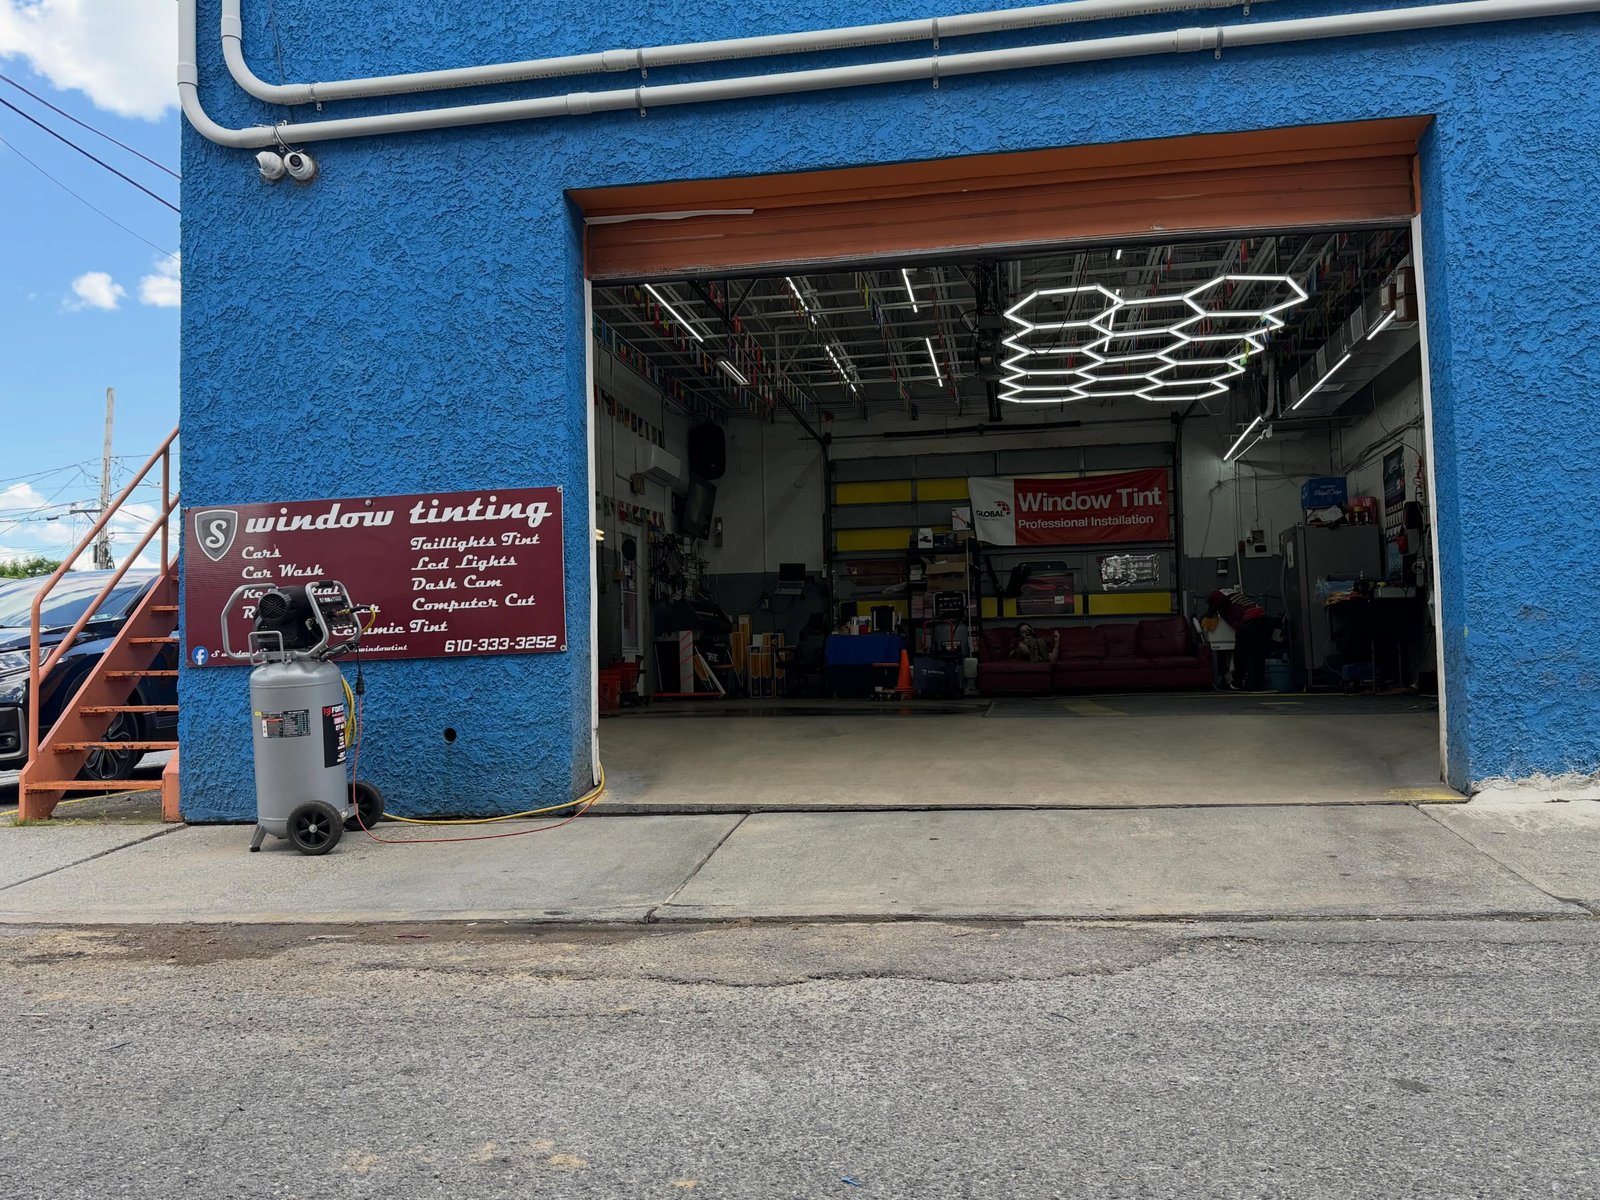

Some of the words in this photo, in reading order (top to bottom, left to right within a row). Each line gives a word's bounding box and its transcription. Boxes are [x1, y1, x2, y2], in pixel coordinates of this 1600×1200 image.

[1018, 491, 1112, 512] Window
[1116, 487, 1162, 508] Tint
[245, 503, 395, 533] window
[409, 495, 552, 528] tinting
[1018, 517, 1088, 530] Professional
[1091, 515, 1154, 527] Installation
[205, 520, 227, 548] S
[410, 535, 497, 552] Taillights
[501, 532, 541, 546] Tint
[241, 545, 282, 559] Cars
[411, 556, 449, 571] Led
[455, 554, 518, 571] Lights
[241, 566, 272, 579] Car
[279, 564, 325, 577] Wash
[411, 577, 457, 591] Dash
[463, 575, 503, 588] Cam
[412, 597, 499, 612] Computer
[505, 593, 536, 607] Cut
[409, 619, 449, 633] Tint
[444, 635, 558, 653] 610-333-3252
